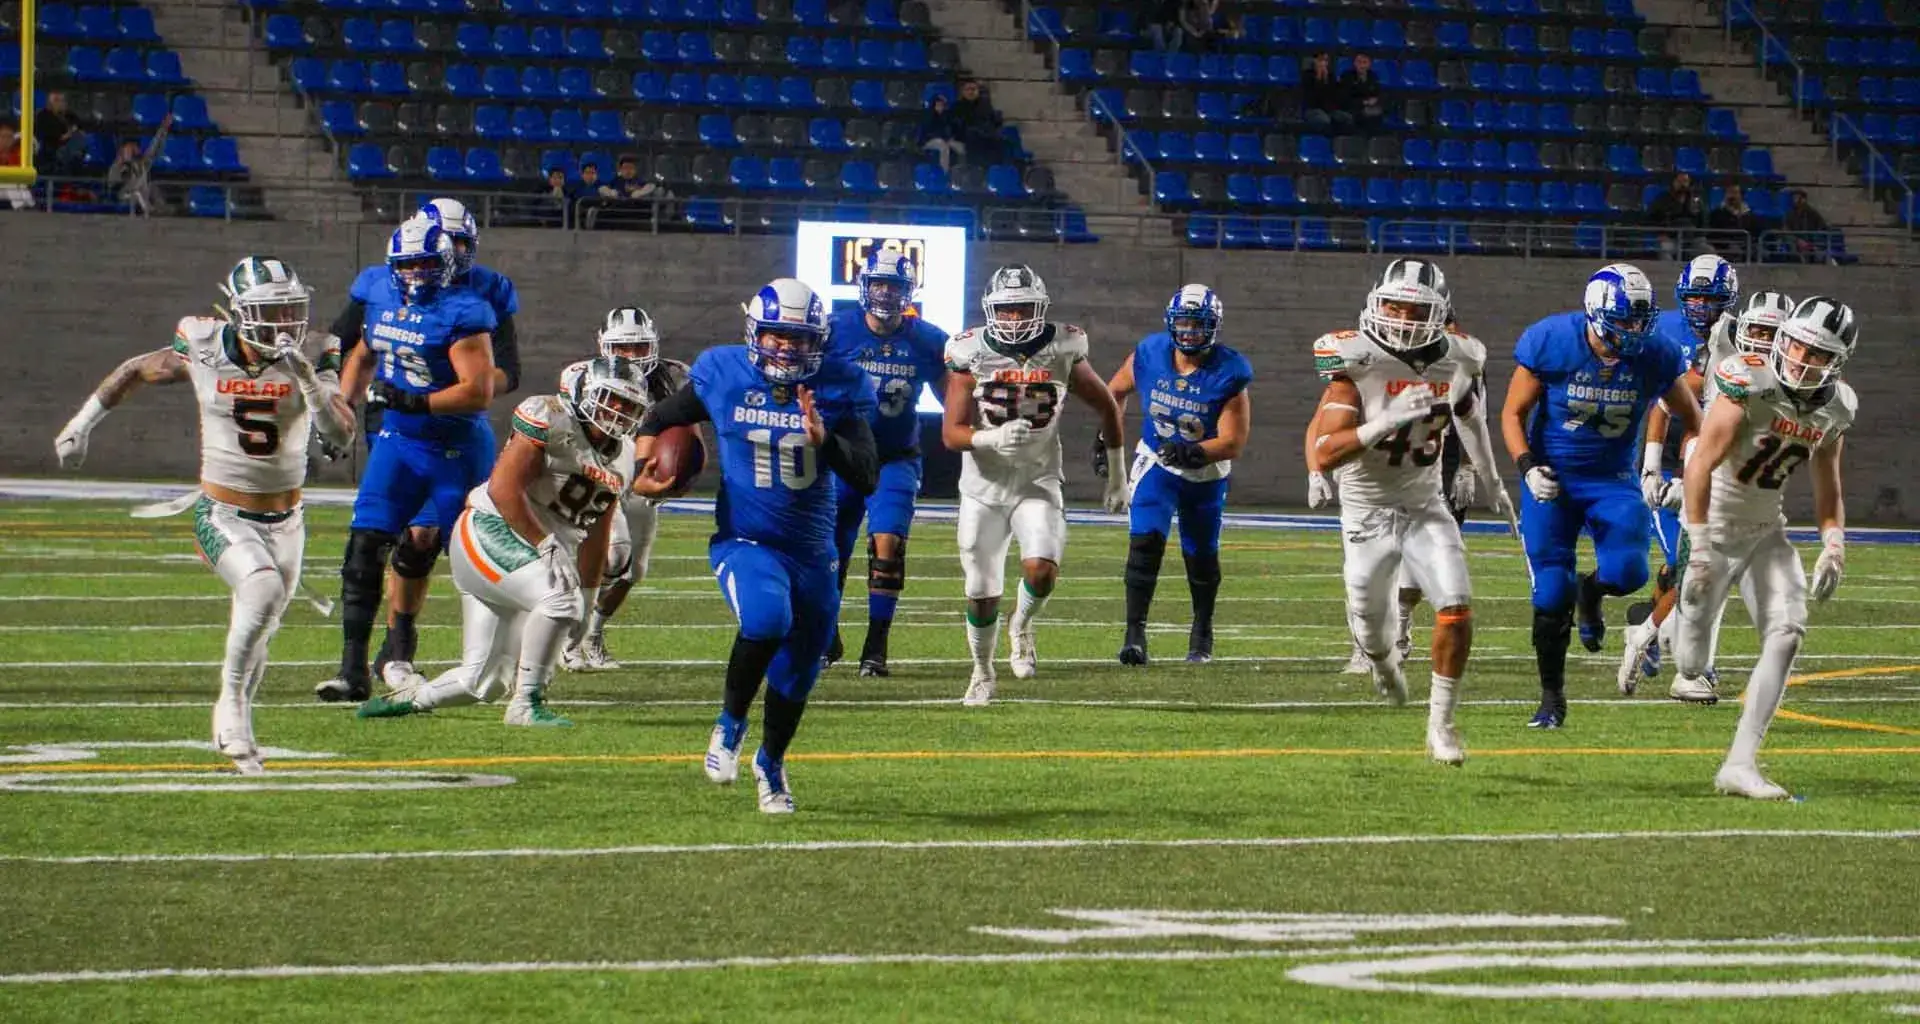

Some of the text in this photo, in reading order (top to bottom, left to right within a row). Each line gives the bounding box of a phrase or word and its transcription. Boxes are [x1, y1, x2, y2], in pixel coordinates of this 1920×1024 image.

[373, 323, 425, 345] BORREGOS
[216, 379, 294, 397] UDLAP
[993, 369, 1052, 384] UDLAP
[1386, 380, 1450, 398] UAP
[1567, 383, 1639, 402] BORREGOS
[982, 381, 1059, 432] 93
[1150, 389, 1208, 414] BORREGOS
[233, 398, 280, 459] 5
[734, 405, 806, 429] BORREG
[1562, 399, 1633, 439] 75
[1771, 417, 1824, 441] UDLAP
[747, 428, 817, 490] 10
[1737, 433, 1811, 489] 10
